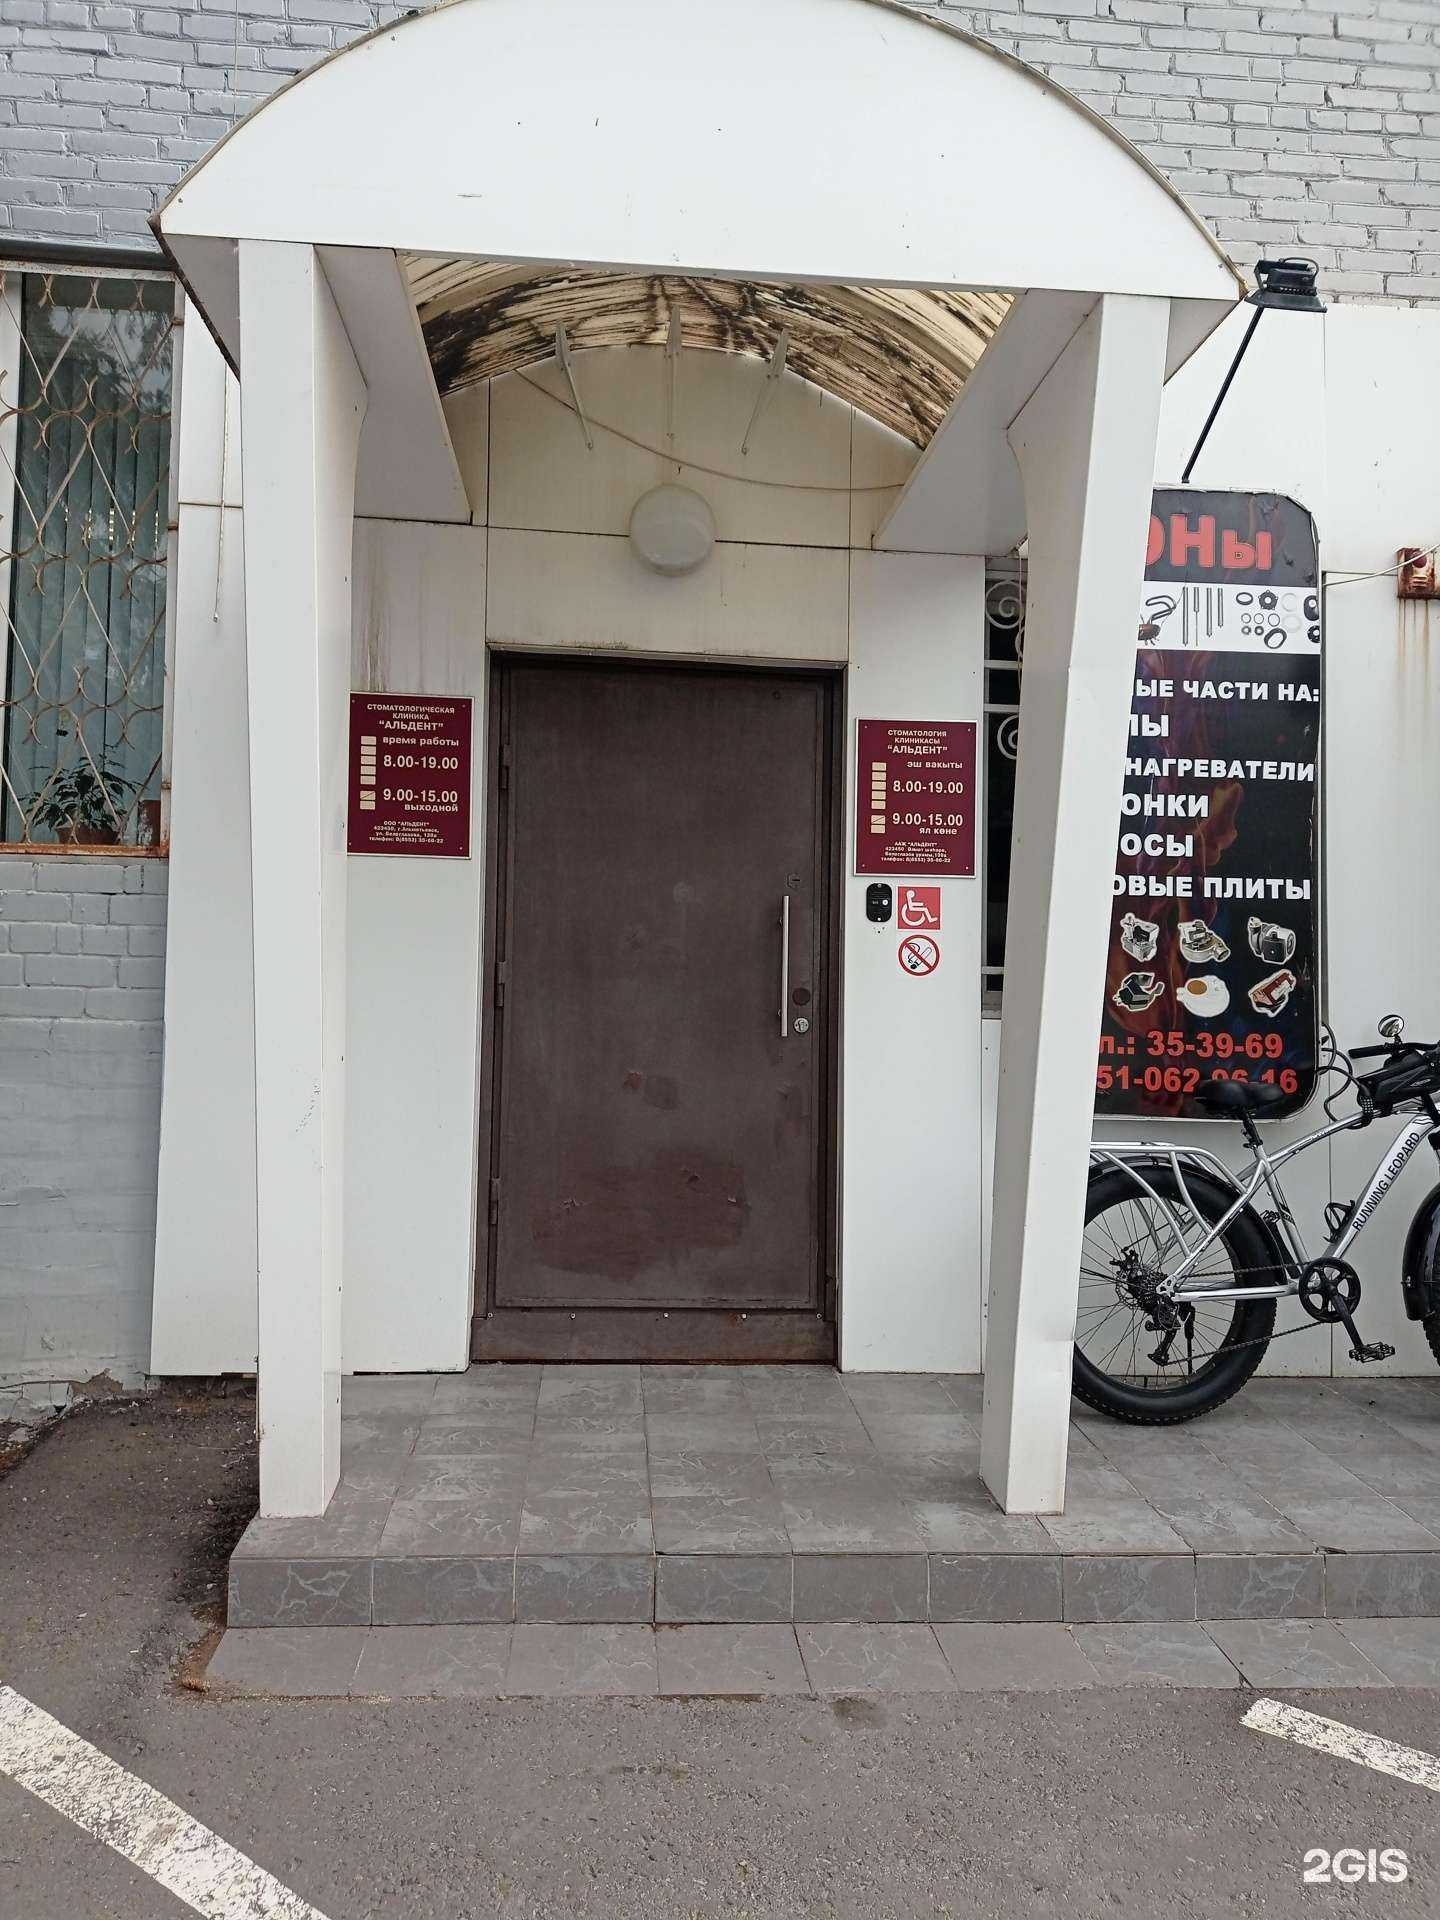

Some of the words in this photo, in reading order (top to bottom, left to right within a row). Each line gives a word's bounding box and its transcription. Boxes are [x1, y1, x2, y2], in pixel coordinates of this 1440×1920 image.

[1183, 680, 1269, 700] ЧАСТИ
[1278, 683, 1319, 702] НА:
[367, 703, 455, 714] СТОМАТОЛОГИЧЕСКАЯ
[392, 712, 430, 720] КЛИНИКА
[379, 719, 444, 732] "АЛЬДЕНТ"
[887, 729, 947, 737] СТОМАТОЛОГИЯ
[382, 736, 417, 745] время
[419, 737, 459, 747] работы
[887, 744, 948, 755] "АЛЬДЕНТ"
[383, 754, 459, 769] 8.00-19.00
[1126, 757, 1315, 782] НАГРЕВАТЕЛИ
[893, 780, 963, 794] 8.00-19.00
[383, 788, 458, 803] 9.00-15.00
[404, 803, 459, 812] выходной
[1121, 793, 1209, 818] ОНКИ
[892, 812, 963, 826] 9.00-15.00
[1120, 832, 1194, 857] ОСЫ
[1203, 877, 1311, 900] ПЛИТЫ
[1147, 1030, 1284, 1058] 35-39-69
[1352, 1179, 1389, 1232] RUNNING
[1384, 1132, 1420, 1181] LEOPARD
